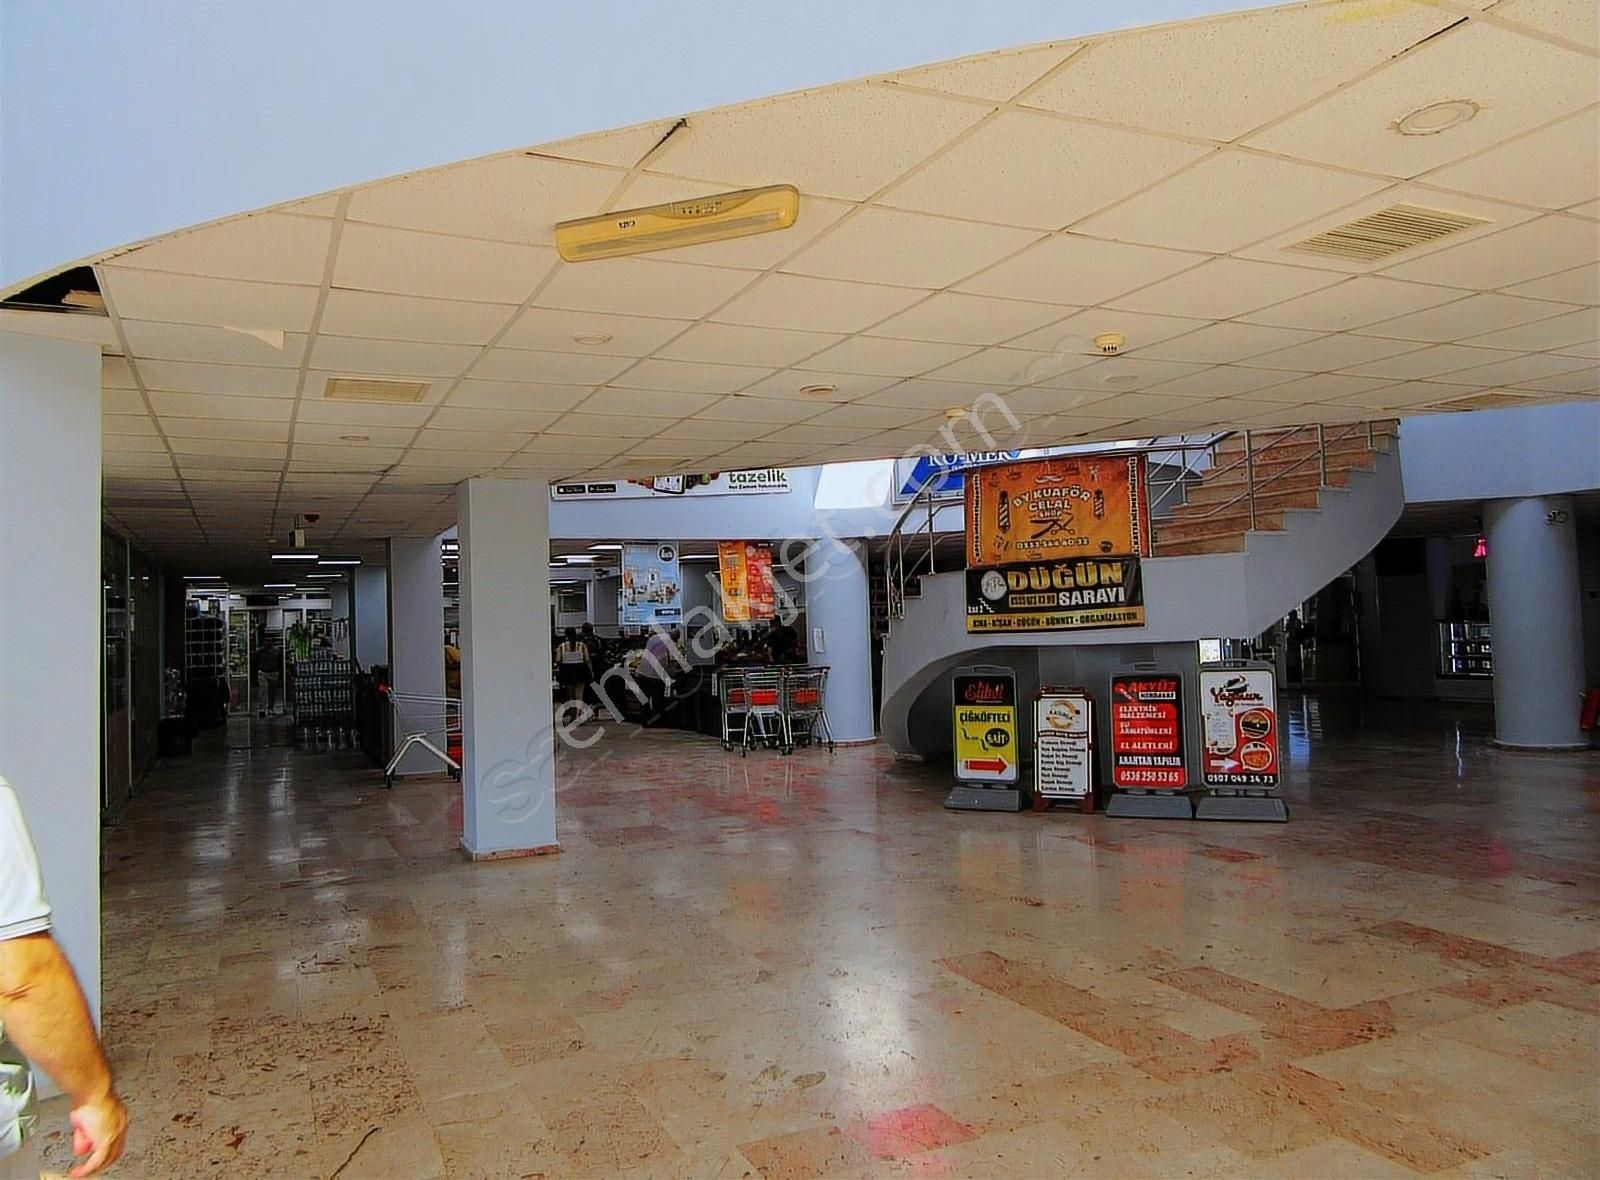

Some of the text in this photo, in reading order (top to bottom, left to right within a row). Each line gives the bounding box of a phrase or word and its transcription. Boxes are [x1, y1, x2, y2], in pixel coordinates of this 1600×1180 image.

[728, 469, 787, 483] tazelik
[1033, 485, 1092, 502] KUAFÖR
[1028, 499, 1072, 511] CELAL
[1008, 561, 1123, 591] DÜĞÜN
[1058, 587, 1126, 607] SARAYI
[1080, 611, 1138, 624] ORGANİZASYON
[1119, 704, 1157, 712] ELEKTRİK
[959, 709, 1010, 724] ÇİĞKÖFTECİ
[1119, 711, 1166, 719] MALZEMESİ
[1120, 741, 1173, 750] EL ALETLERİ
[1119, 755, 1181, 766] ANAHTAR YAPILIR
